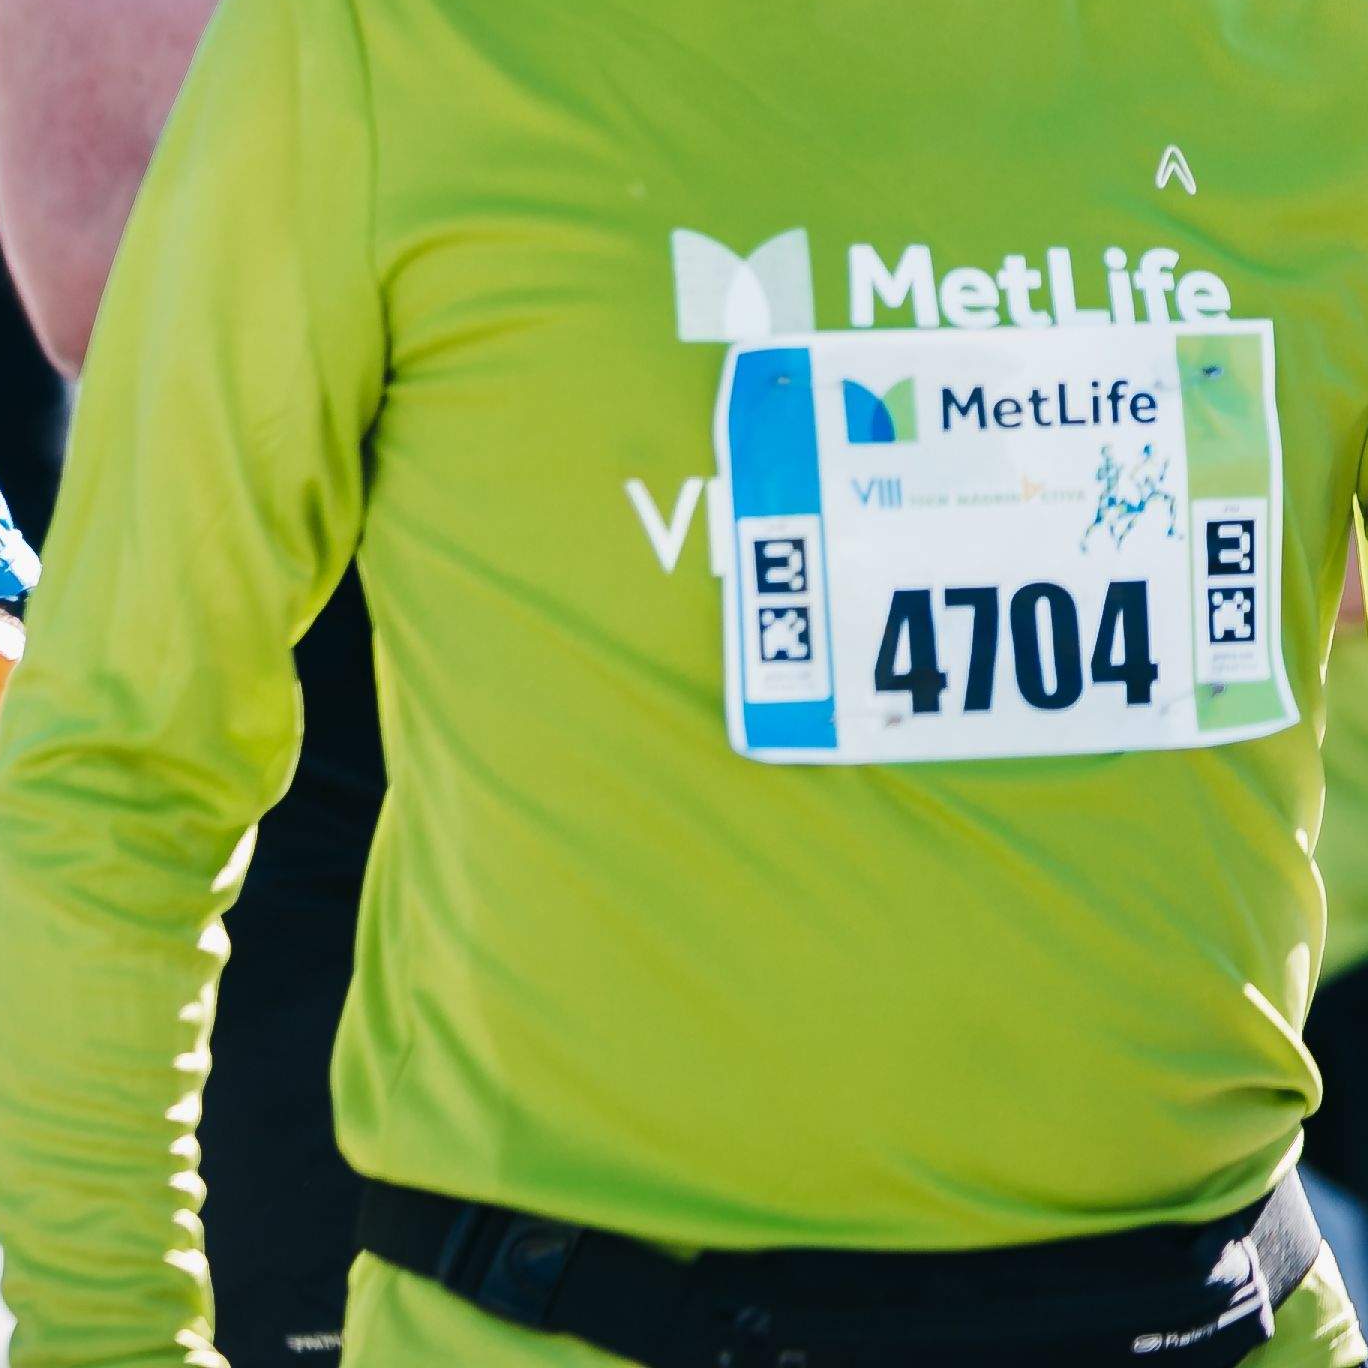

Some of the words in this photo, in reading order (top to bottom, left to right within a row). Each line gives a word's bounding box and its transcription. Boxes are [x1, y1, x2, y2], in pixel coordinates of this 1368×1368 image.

[847, 243, 1233, 328] MetLife
[940, 380, 1160, 433] MetLife
[850, 476, 904, 510] VIII
[873, 578, 1159, 715] 4704
